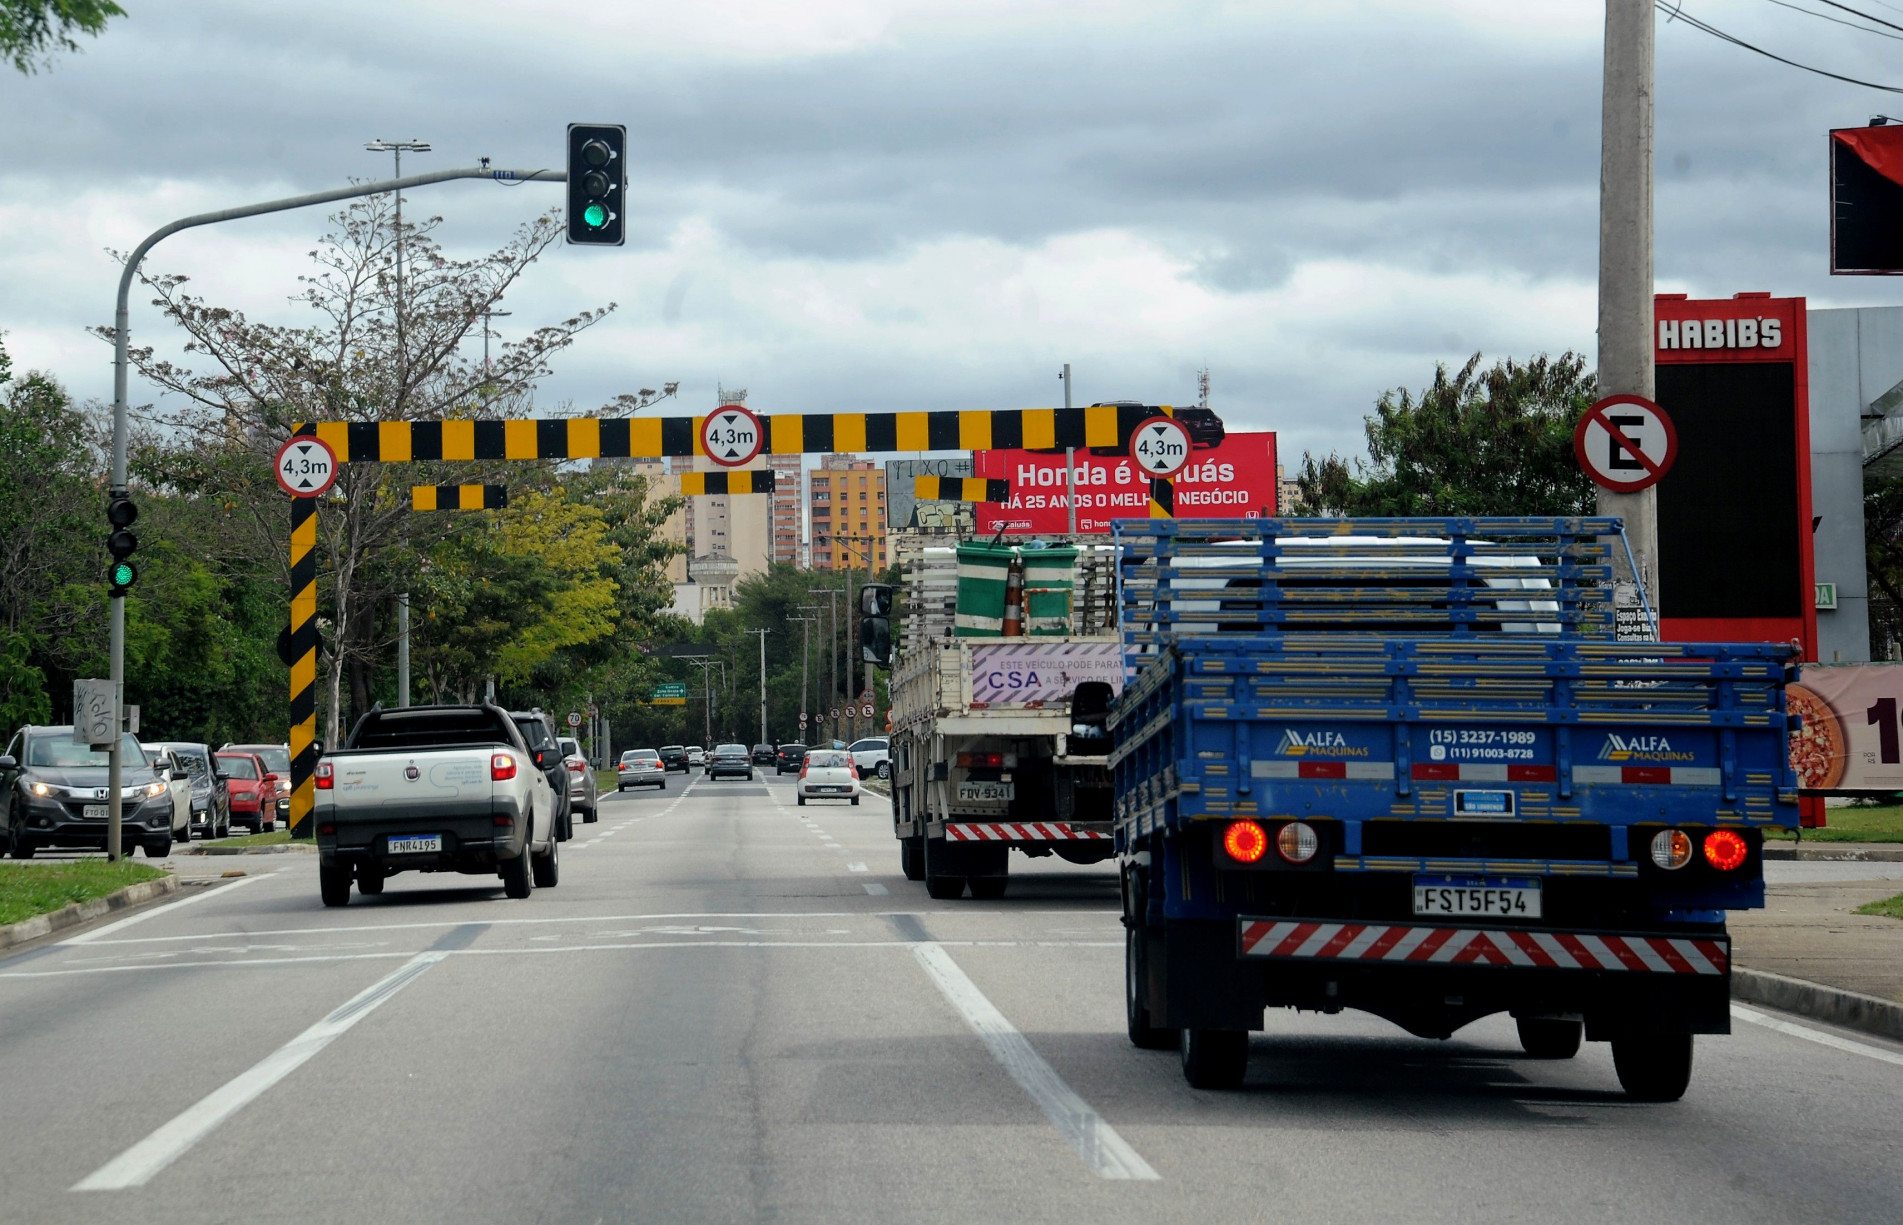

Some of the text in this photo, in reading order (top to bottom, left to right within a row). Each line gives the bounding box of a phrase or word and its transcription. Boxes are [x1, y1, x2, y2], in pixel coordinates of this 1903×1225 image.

[1658, 316, 1782, 350] HABIB'S
[709, 429, 753, 447] 4,3m
[1138, 440, 1183, 458] 4,3m
[283, 459, 327, 477] 4,3m
[1018, 461, 1107, 487] Honda
[1114, 460, 1131, 484] é
[1026, 495, 1046, 508] 25
[1049, 494, 1092, 509] ANOS
[1096, 494, 1107, 507] O
[1179, 487, 1249, 505] NEGÓCIO
[1000, 660, 1023, 669] ESTE
[1025, 659, 1065, 669] VEÍCULO
[1067, 660, 1092, 669] PODE
[988, 671, 1042, 689] CSA
[570, 714, 580, 722] 70
[1304, 731, 1346, 746] ALFA
[1430, 729, 1536, 744] (15) 3237-1989
[1628, 737, 1671, 752] ALFA
[1309, 746, 1369, 757] MAQUINAS
[1450, 747, 1534, 759] (11) 91003-8728
[1633, 751, 1694, 762] MAQUINAS
[1425, 888, 1526, 913] FST5F54
